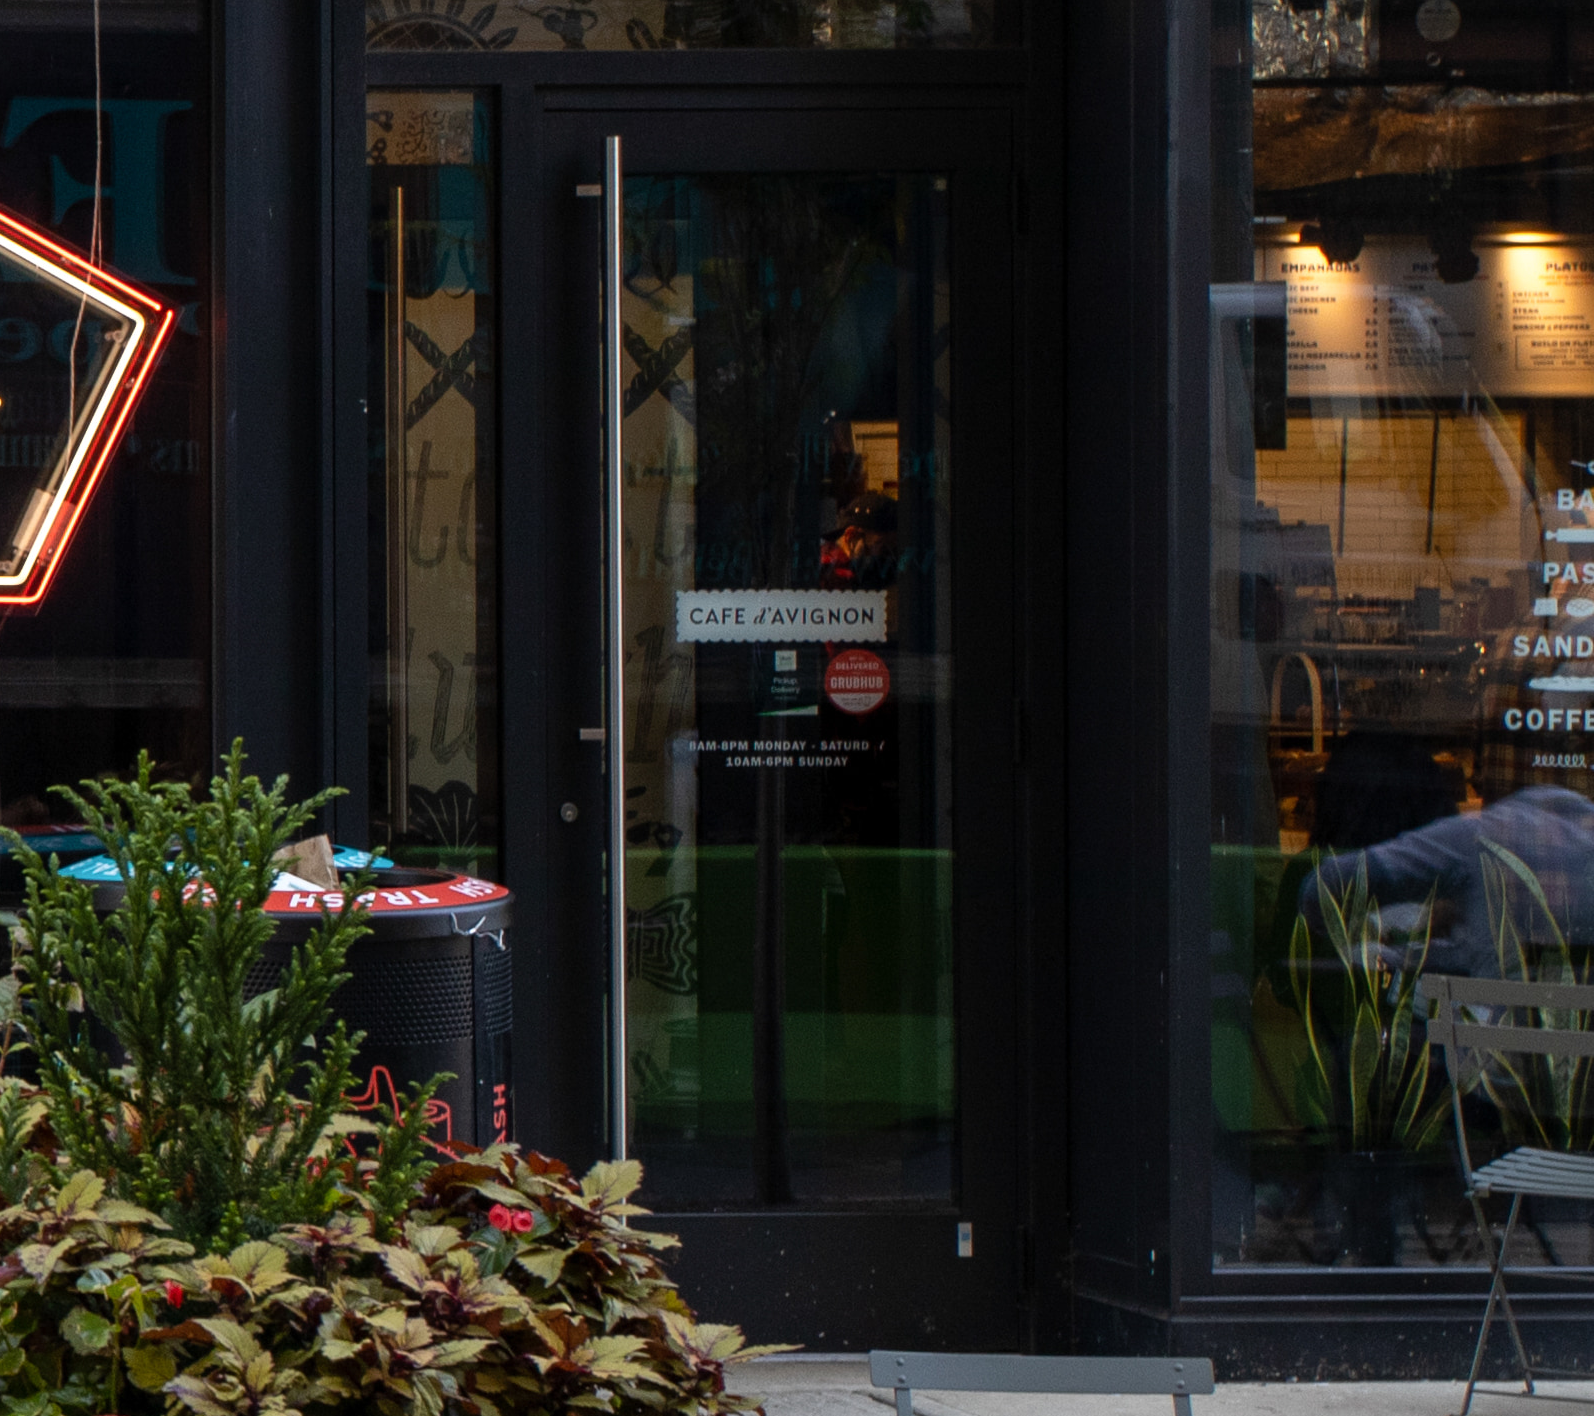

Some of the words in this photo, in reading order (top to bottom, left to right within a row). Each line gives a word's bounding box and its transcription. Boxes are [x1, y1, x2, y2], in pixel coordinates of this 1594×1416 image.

[689, 607, 746, 625] CAFE
[835, 661, 880, 671] DELIVERED
[830, 676, 884, 689] GRUBHUB
[753, 740, 806, 752] MONDAY
[820, 740, 885, 752] SATURD
[798, 755, 849, 768] SUNDAY
